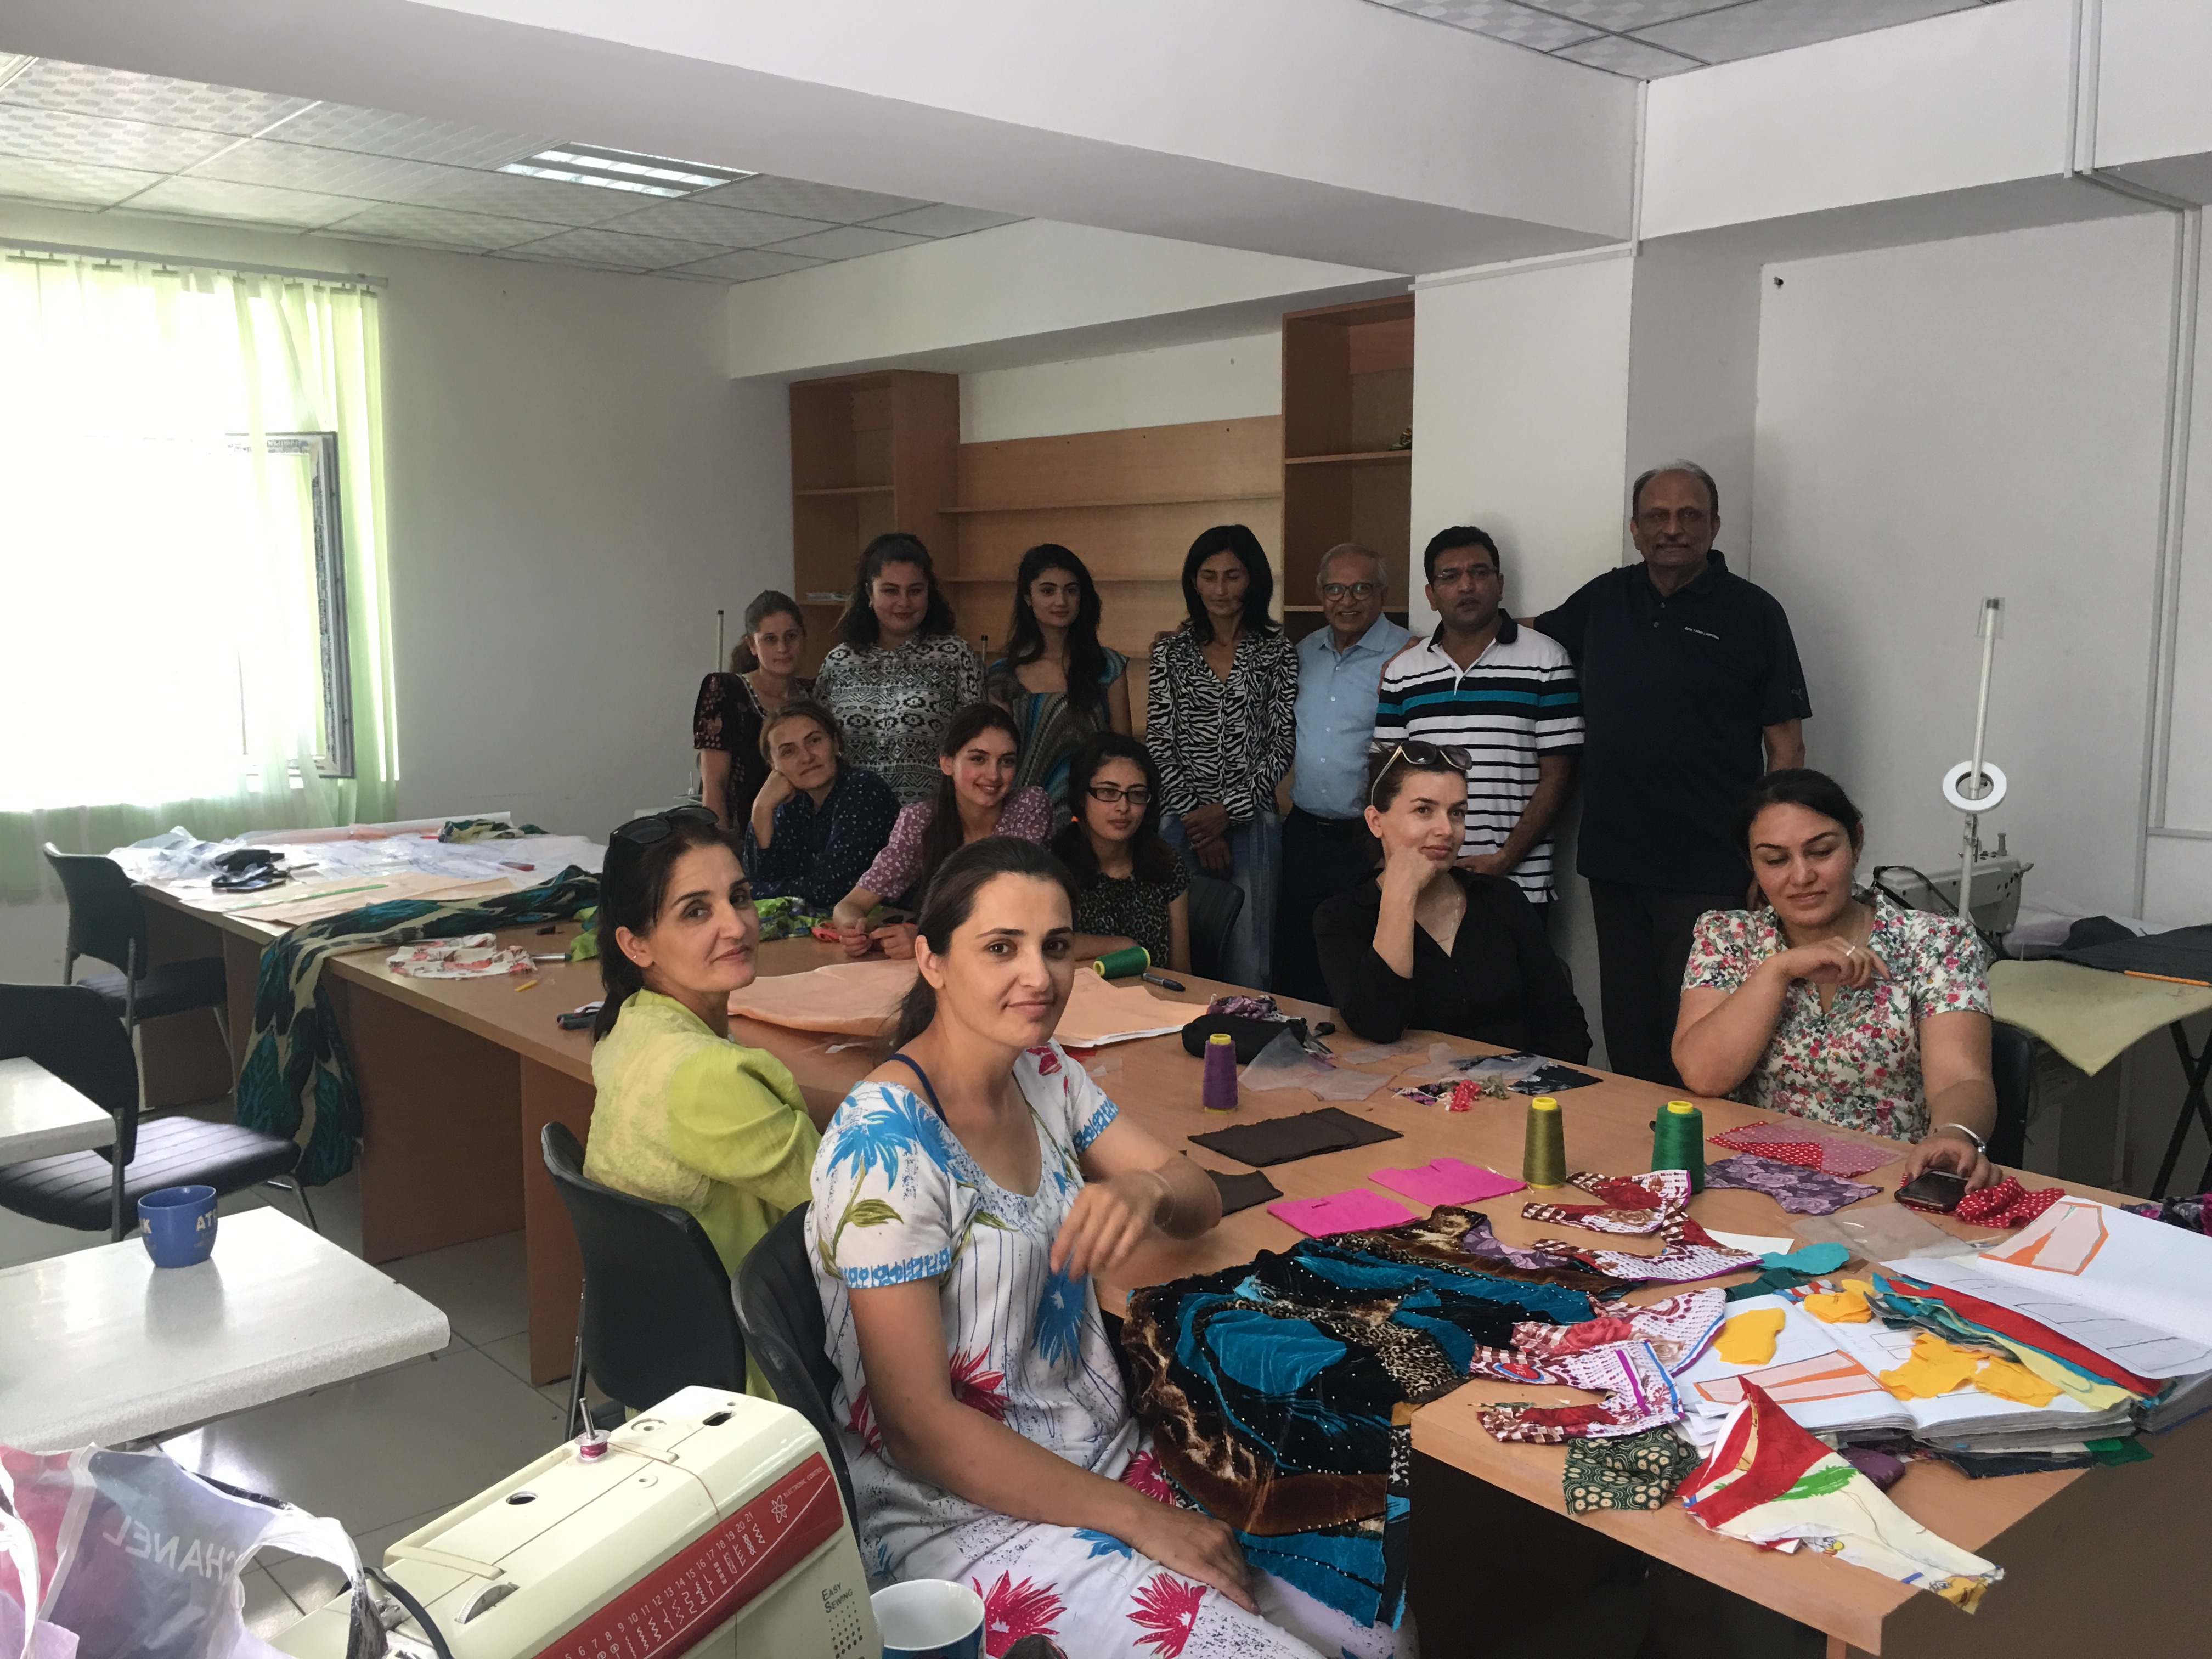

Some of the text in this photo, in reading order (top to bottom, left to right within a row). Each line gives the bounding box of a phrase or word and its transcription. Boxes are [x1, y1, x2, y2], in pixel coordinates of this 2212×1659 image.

[578, 1646, 585, 1656] 6
[591, 1638, 598, 1649] 7
[605, 1631, 612, 1641] 8
[618, 1622, 625, 1632] 9
[628, 1612, 638, 1624] 10
[640, 1604, 651, 1616] 11
[652, 1595, 663, 1607] 12
[664, 1587, 674, 1598] 13
[675, 1577, 685, 1589] 14
[686, 1568, 696, 1580] 15
[696, 1559, 706, 1570] 16
[706, 1549, 714, 1561] 17
[716, 1539, 726, 1551] 18
[725, 1531, 735, 1542] 19
[735, 1521, 745, 1533] 20
[744, 1511, 753, 1522] 21
